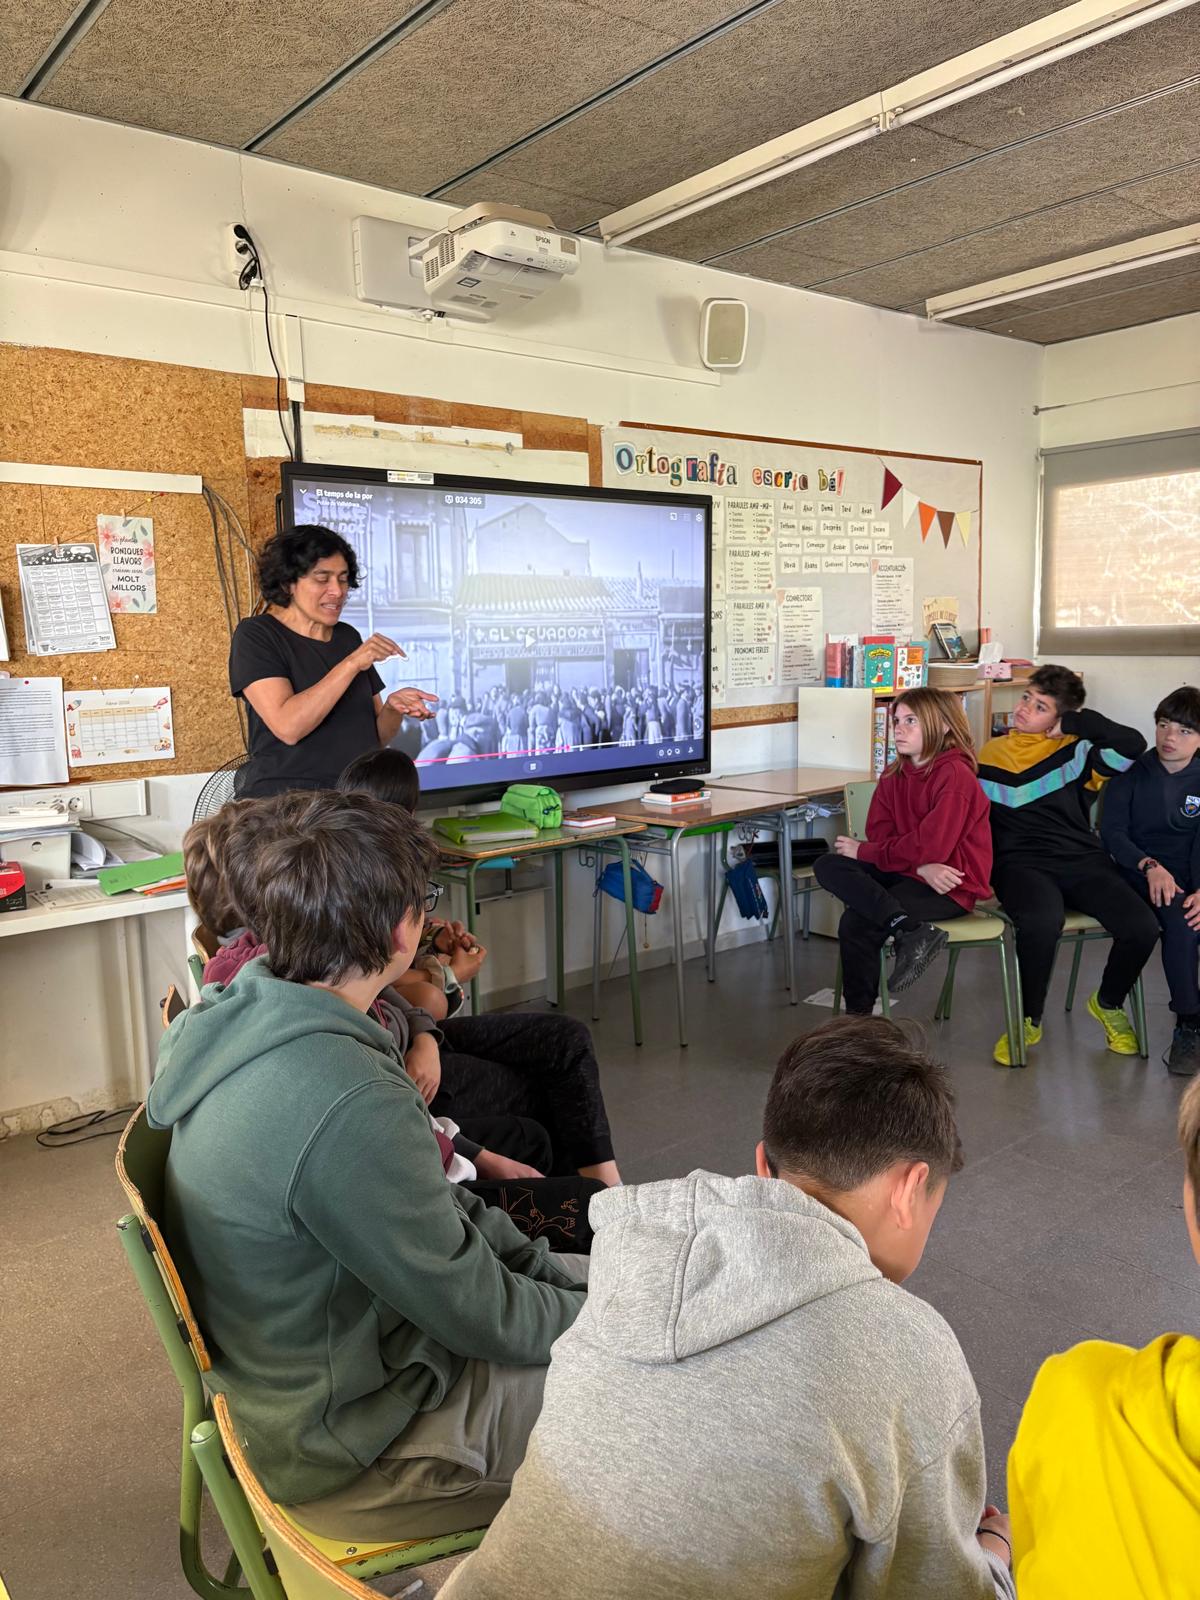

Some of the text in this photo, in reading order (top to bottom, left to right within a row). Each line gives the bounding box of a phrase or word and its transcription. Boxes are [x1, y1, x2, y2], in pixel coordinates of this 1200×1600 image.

[535, 235, 551, 244] EPSON
[615, 446, 738, 487] Ortografia
[324, 490, 344, 499] temps
[455, 496, 482, 505] 034 305
[728, 501, 749, 510] PARAULES
[750, 502, 759, 510] AMB
[821, 504, 833, 512] Demà
[823, 522, 841, 532] Després
[110, 546, 144, 556] BONIQUES
[113, 556, 142, 565] LLAVORS
[111, 584, 147, 592] MILLORS
[786, 594, 813, 602] CONNECTORS
[734, 602, 754, 610] PARAULES
[734, 647, 754, 655] PRONOMS
